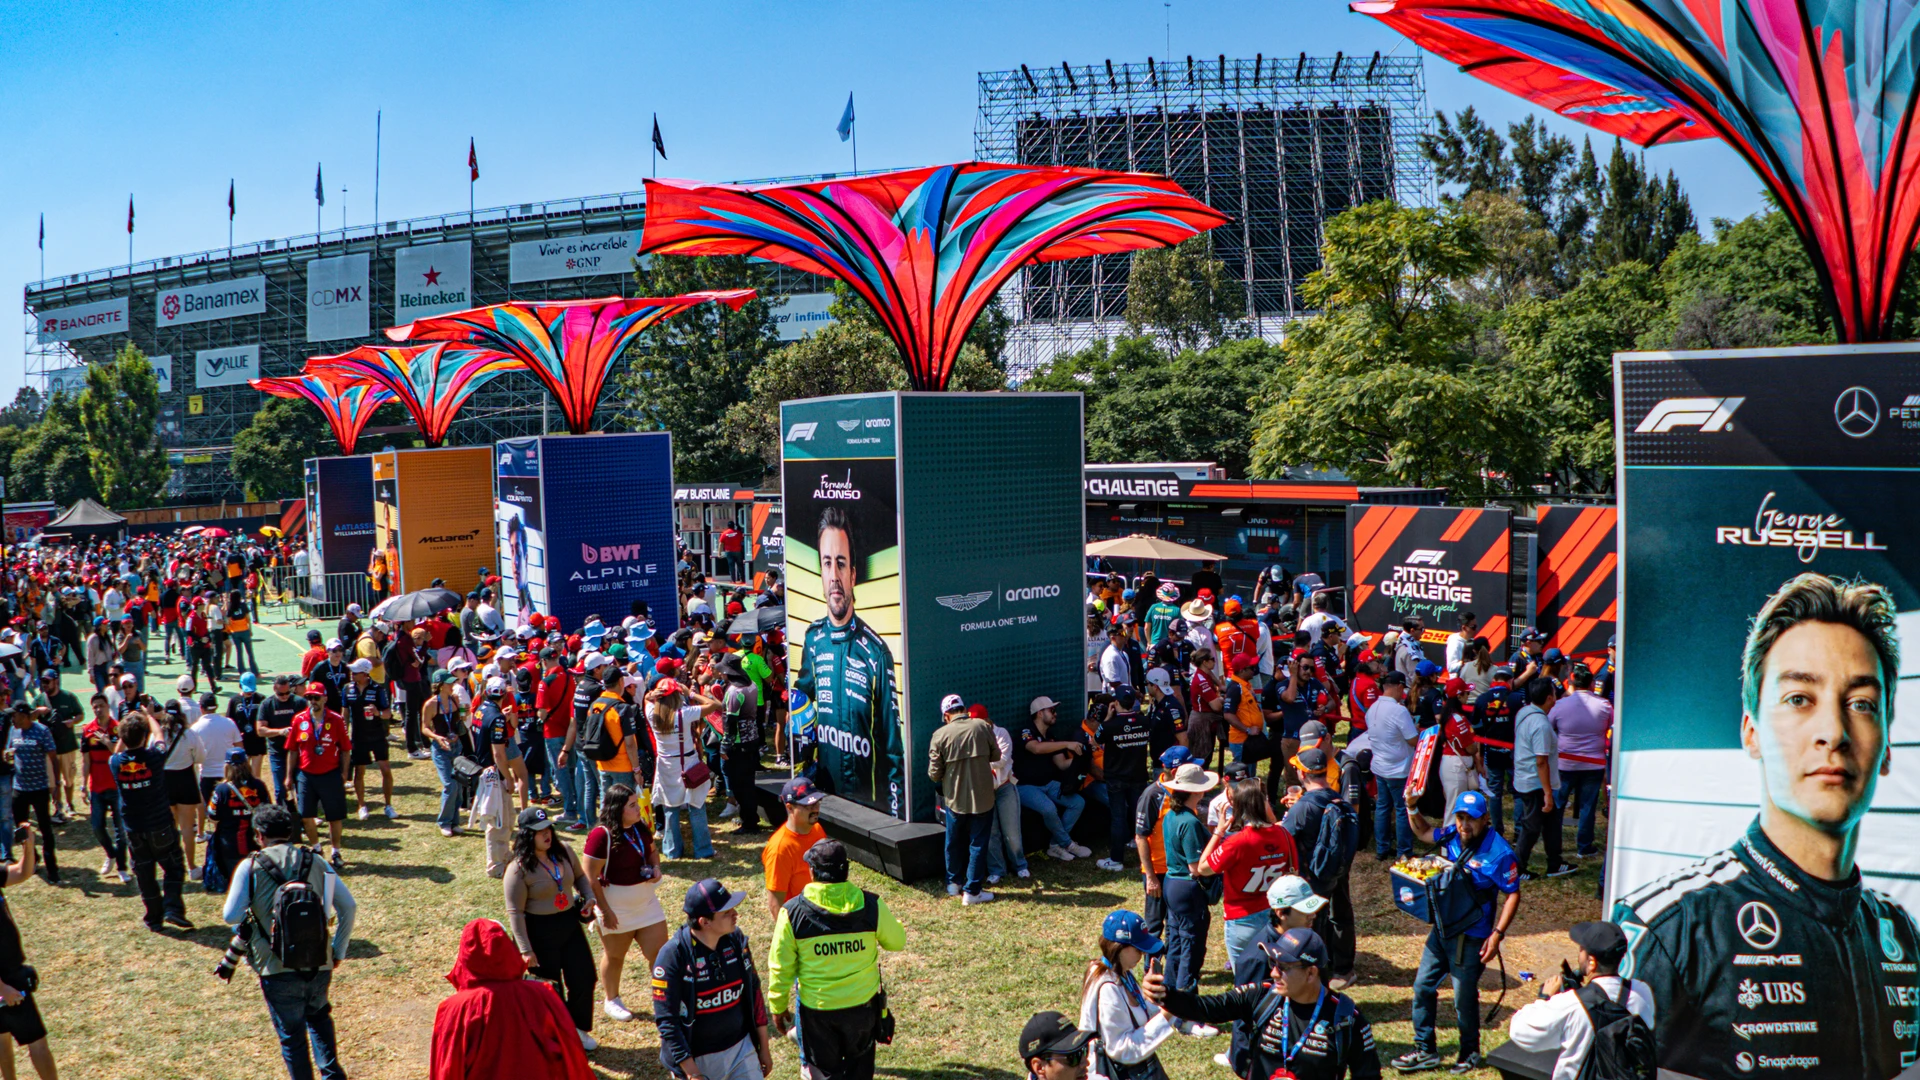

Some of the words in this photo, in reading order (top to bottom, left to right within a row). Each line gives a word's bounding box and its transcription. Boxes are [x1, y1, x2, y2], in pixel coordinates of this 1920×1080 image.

[539, 244, 564, 256] Vivir
[567, 246, 577, 254] es
[580, 236, 628, 252] increíble
[576, 256, 601, 268] GNP
[184, 288, 260, 313] Banamex
[312, 286, 362, 306] CDMX
[400, 290, 466, 308] Heineken
[60, 310, 122, 330] BANORTE
[205, 354, 250, 377] VALUE
[193, 403, 198, 412] 7
[1634, 396, 1746, 432] F1
[786, 422, 818, 442] F1
[865, 418, 891, 428] aramco
[821, 468, 852, 491] Fernando
[1089, 479, 1179, 496] CHALLENGE
[690, 488, 710, 500] BLAST
[711, 488, 730, 500] LANE
[813, 489, 861, 499] ALONSO
[1756, 491, 1846, 564] George
[1716, 526, 1888, 550] RUSSELL
[600, 544, 640, 563] BWT
[1405, 549, 1447, 565] F1
[569, 564, 657, 581] ALPINE
[1393, 566, 1459, 586] PITSTOP
[578, 582, 610, 593] FORMULA
[631, 579, 649, 588] TEAM
[1006, 584, 1060, 601] aramco
[1380, 580, 1472, 604] CHALLENGE
[1390, 596, 1412, 612] Test
[1412, 604, 1432, 616] your
[1432, 602, 1458, 622] speed
[960, 620, 996, 632] FORMULA
[1017, 615, 1037, 624] TEAM
[818, 724, 870, 757] aramco
[1744, 841, 1800, 894] TeamViewer
[1242, 862, 1286, 893] 16
[814, 939, 866, 956] CONTROL
[1756, 954, 1802, 966] AMG
[1881, 962, 1917, 972] PETRONAS
[697, 992, 722, 1009] Red
[1762, 982, 1806, 1004] UBS
[1740, 1021, 1819, 1034] CROWDSTRIKE
[1758, 1055, 1820, 1070] Snapdragon
